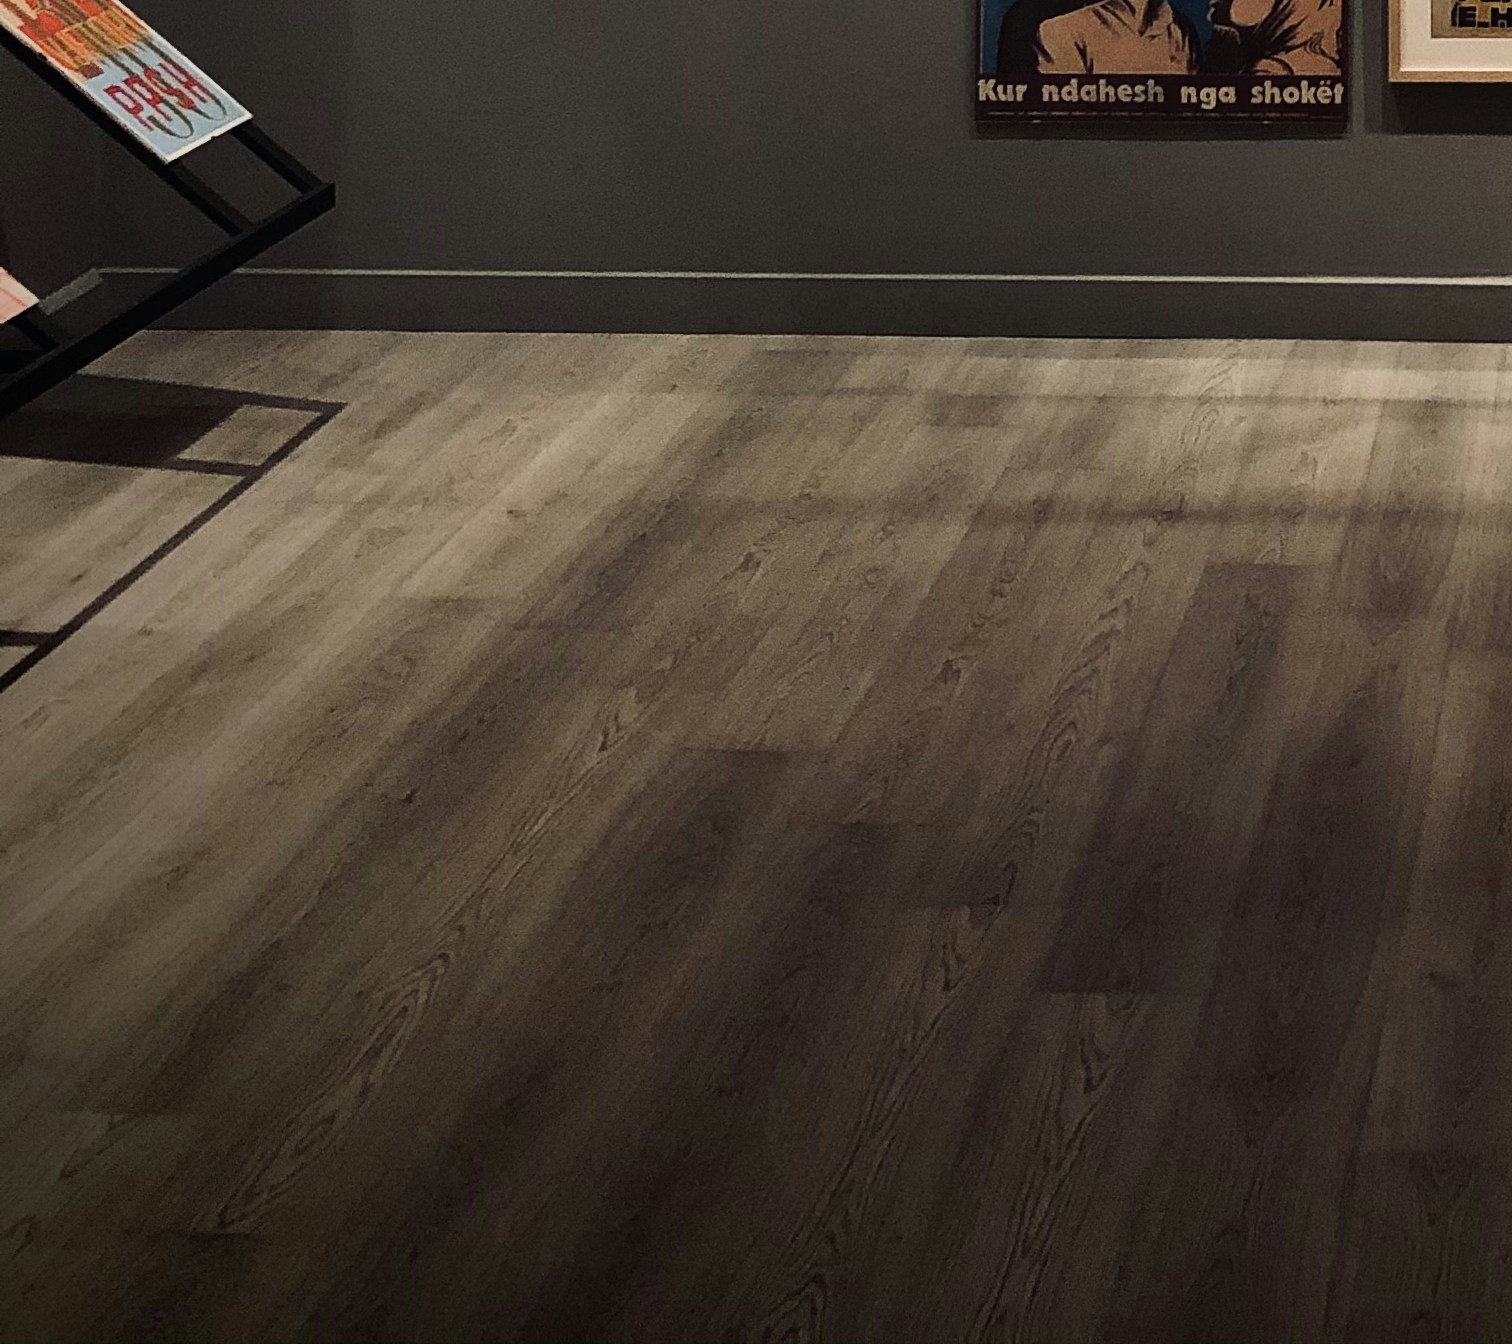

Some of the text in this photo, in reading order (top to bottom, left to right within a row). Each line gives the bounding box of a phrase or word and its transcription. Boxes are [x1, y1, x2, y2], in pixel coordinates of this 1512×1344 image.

[103, 61, 208, 132] PPSH
[978, 78, 1345, 110] Kur ndahesh nga shokët
